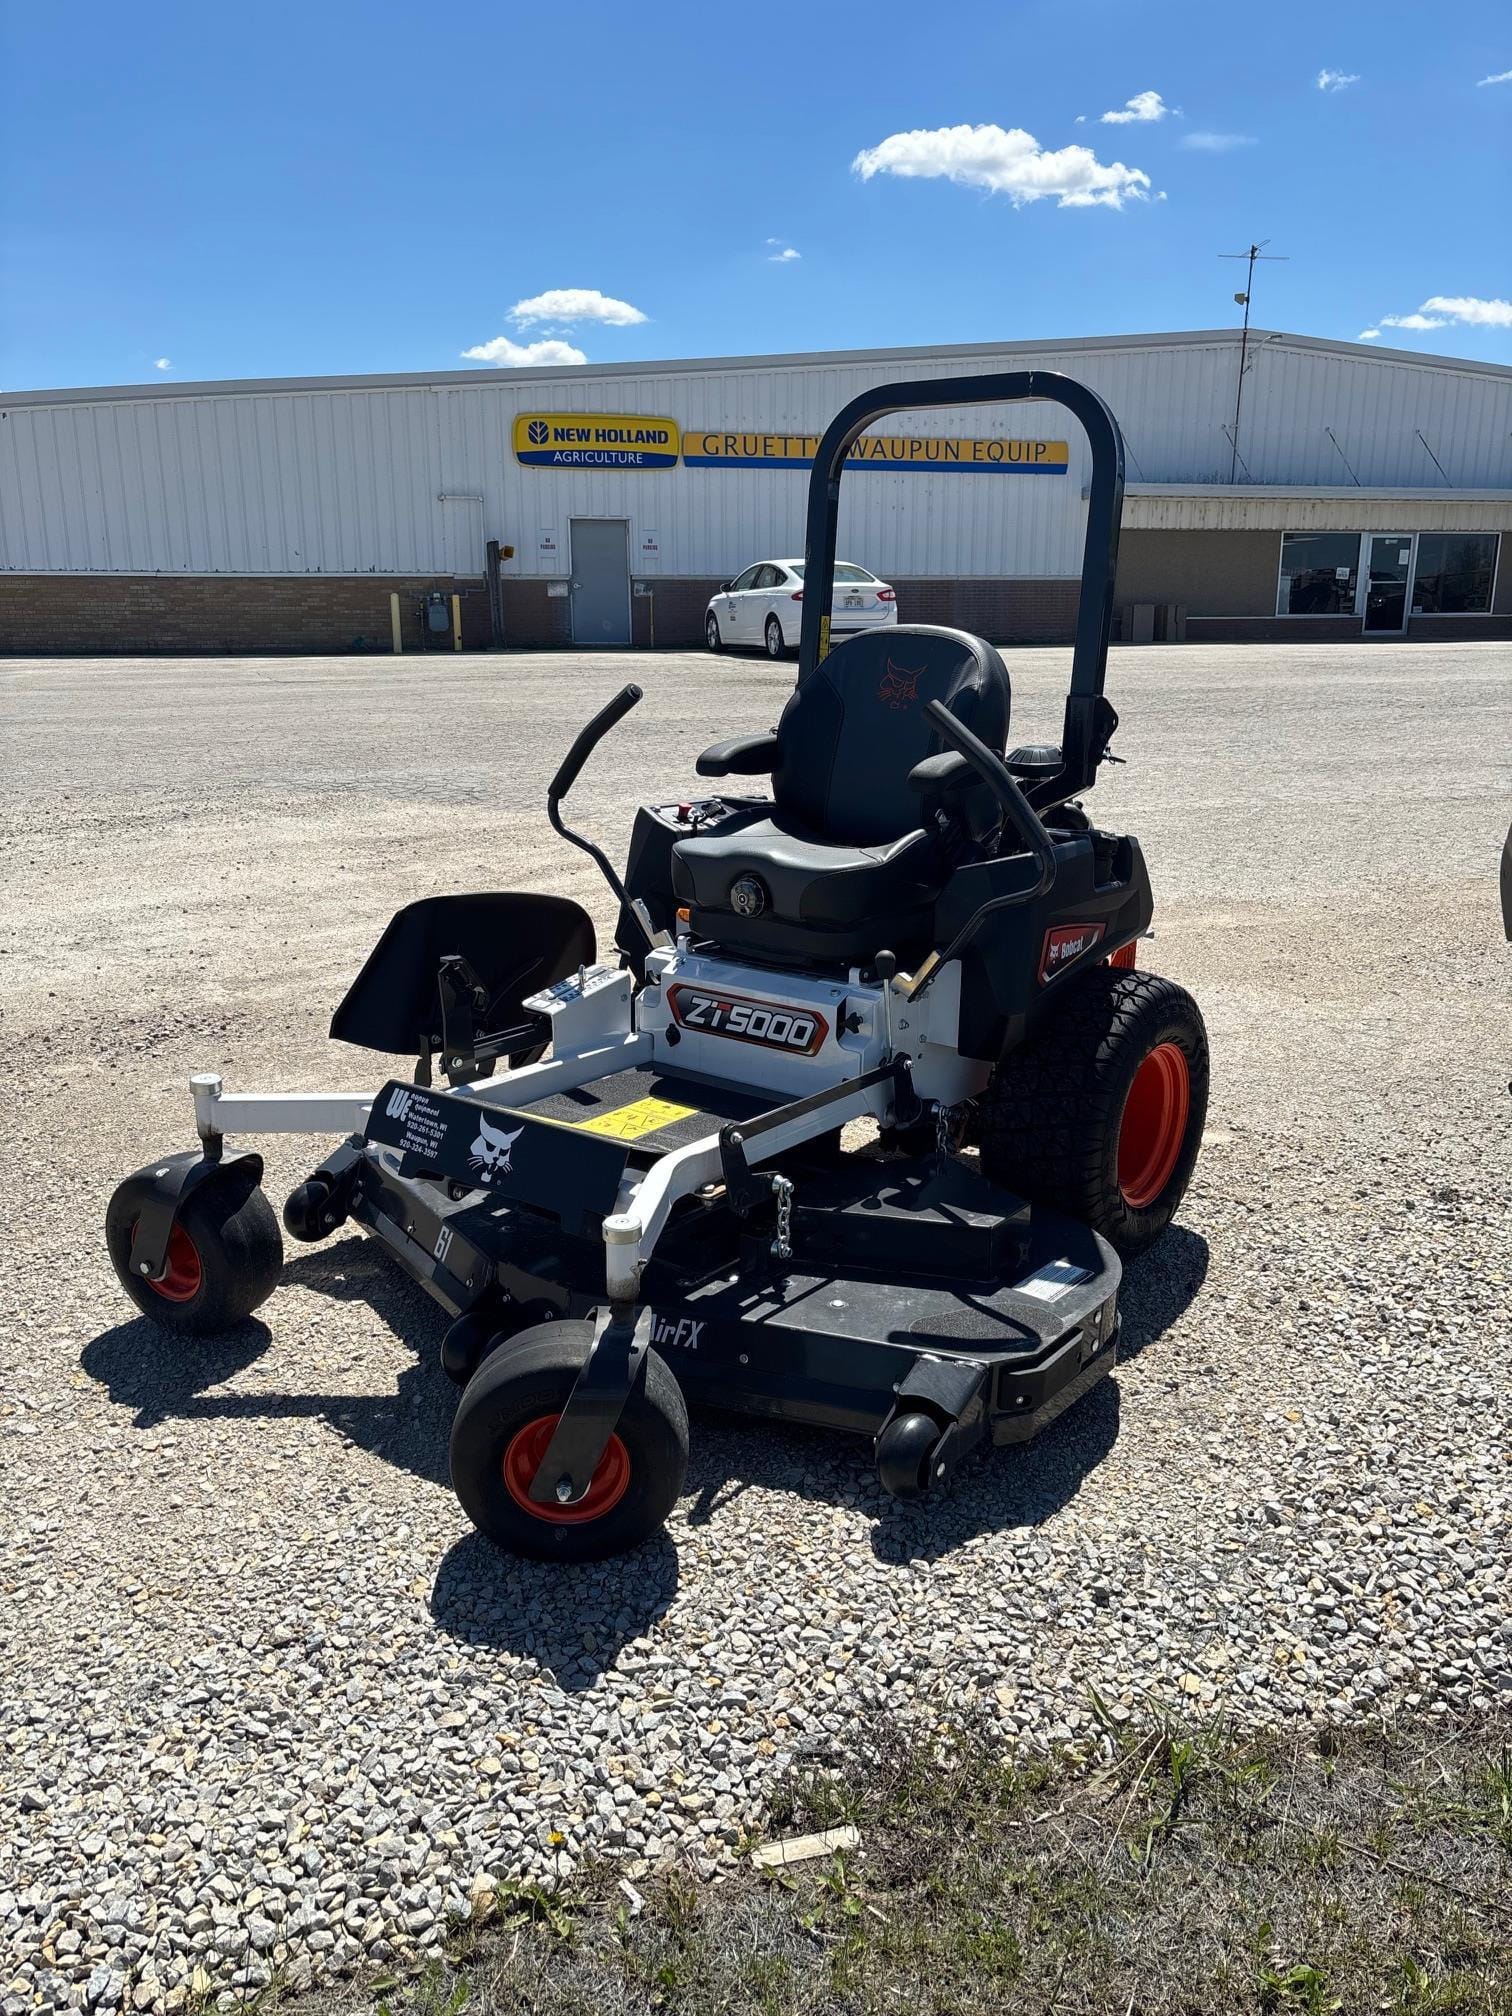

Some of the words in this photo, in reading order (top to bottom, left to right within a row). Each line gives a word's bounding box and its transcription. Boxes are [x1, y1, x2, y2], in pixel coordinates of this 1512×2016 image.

[553, 427, 591, 443] NEW
[595, 428, 669, 444] HOLLAND
[553, 451, 643, 464] AGRICULTURE
[702, 434, 819, 457] GRUETT'
[849, 438, 960, 461] WAUPUN
[973, 441, 1052, 463] EQUIP.
[1061, 936, 1084, 960] Bobcat
[685, 996, 815, 1047] ZT5000
[408, 1112, 439, 1130] Watertown,
[406, 1131, 429, 1147] Waupun,
[430, 1140, 439, 1149] WI
[433, 1225, 454, 1262] 61
